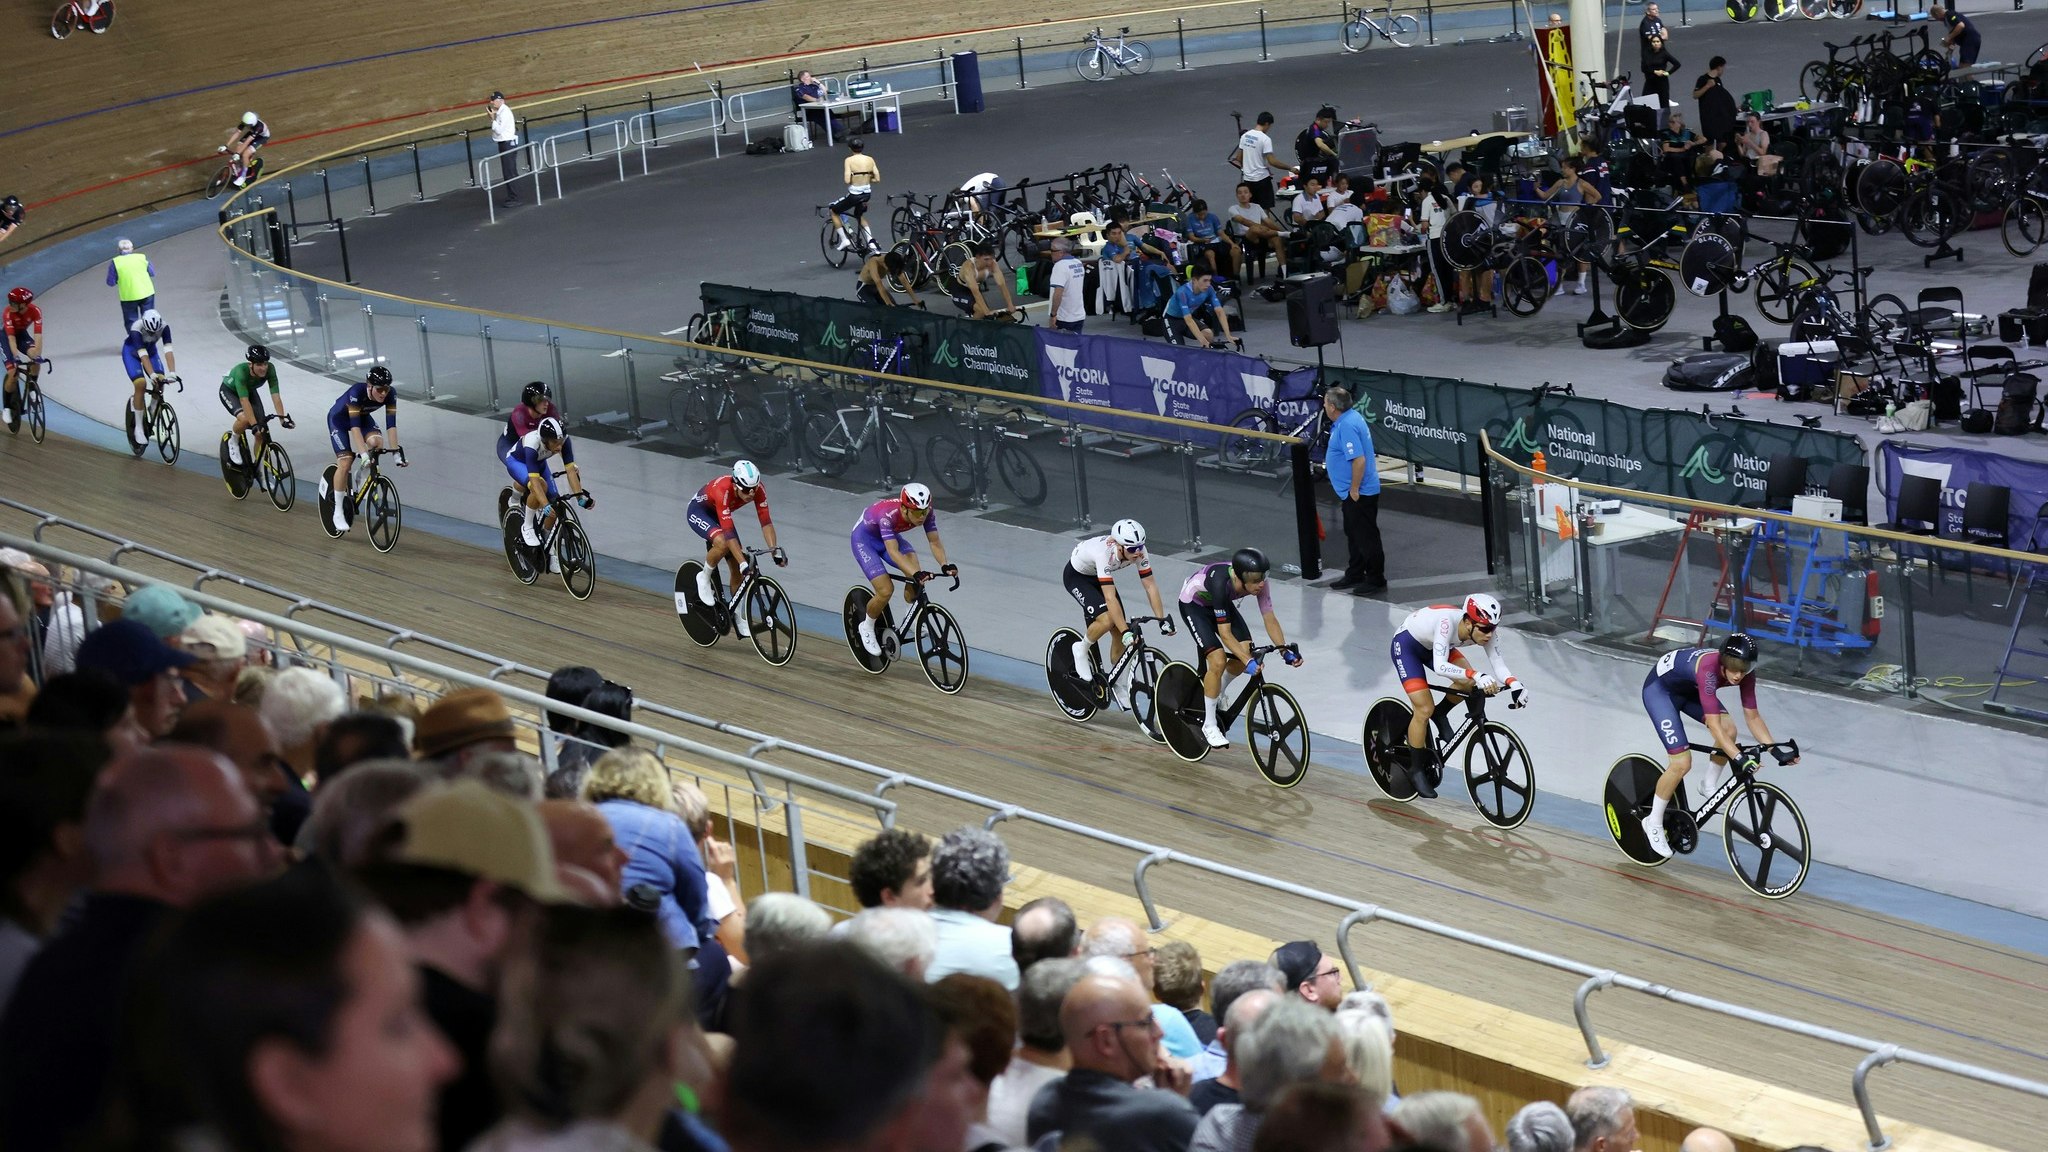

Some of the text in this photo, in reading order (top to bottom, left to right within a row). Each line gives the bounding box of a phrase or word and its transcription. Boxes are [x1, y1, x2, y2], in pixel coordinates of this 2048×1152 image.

[747, 321, 799, 343] Championships
[962, 343, 998, 359] National
[963, 357, 1029, 380] Championships
[1056, 364, 1110, 386] VICTORIA
[1075, 386, 1094, 397] State
[1151, 377, 1209, 401] VICTORIA
[1172, 399, 1190, 411] State
[1173, 408, 1209, 423] Government
[1385, 399, 1426, 420] National
[1383, 415, 1467, 444] Championships
[1548, 424, 1596, 446] National
[1549, 442, 1642, 474] Championships
[1733, 452, 1771, 473] Natio
[688, 513, 711, 532] SASI
[1660, 718, 1679, 746] QAS
[1695, 785, 1728, 823] ARGON
[1726, 776, 1738, 790] 18
